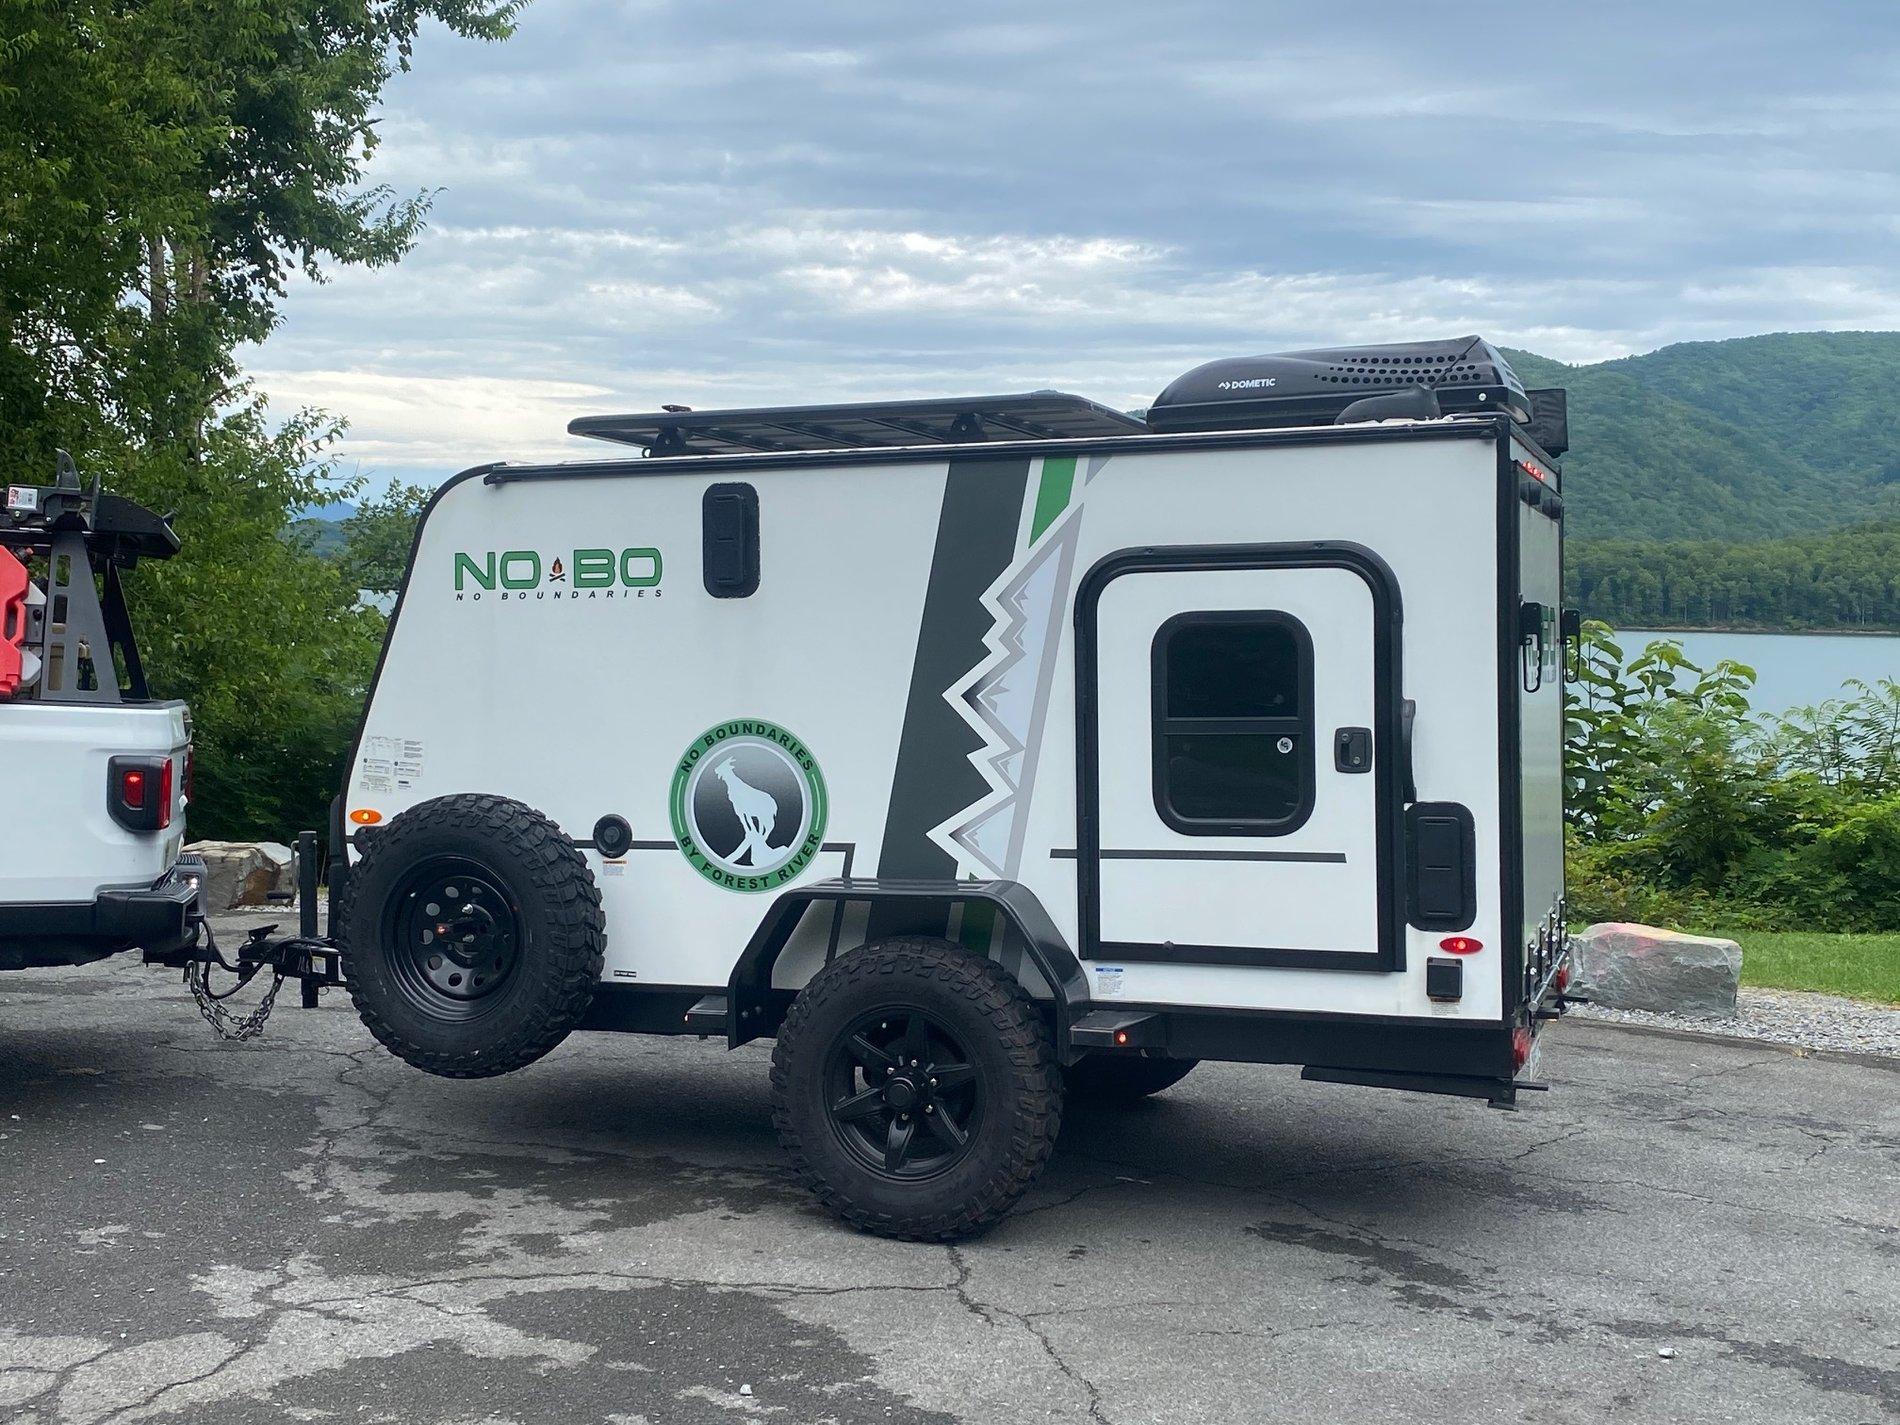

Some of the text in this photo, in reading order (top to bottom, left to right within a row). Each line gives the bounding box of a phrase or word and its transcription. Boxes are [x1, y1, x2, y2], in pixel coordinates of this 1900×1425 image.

[1231, 378, 1276, 389] DOMETIC
[456, 589, 662, 601] NO BOUNDARIES
[681, 723, 814, 773] NO BOUNDARIES
[680, 833, 820, 889] BY FOREST RIVER
